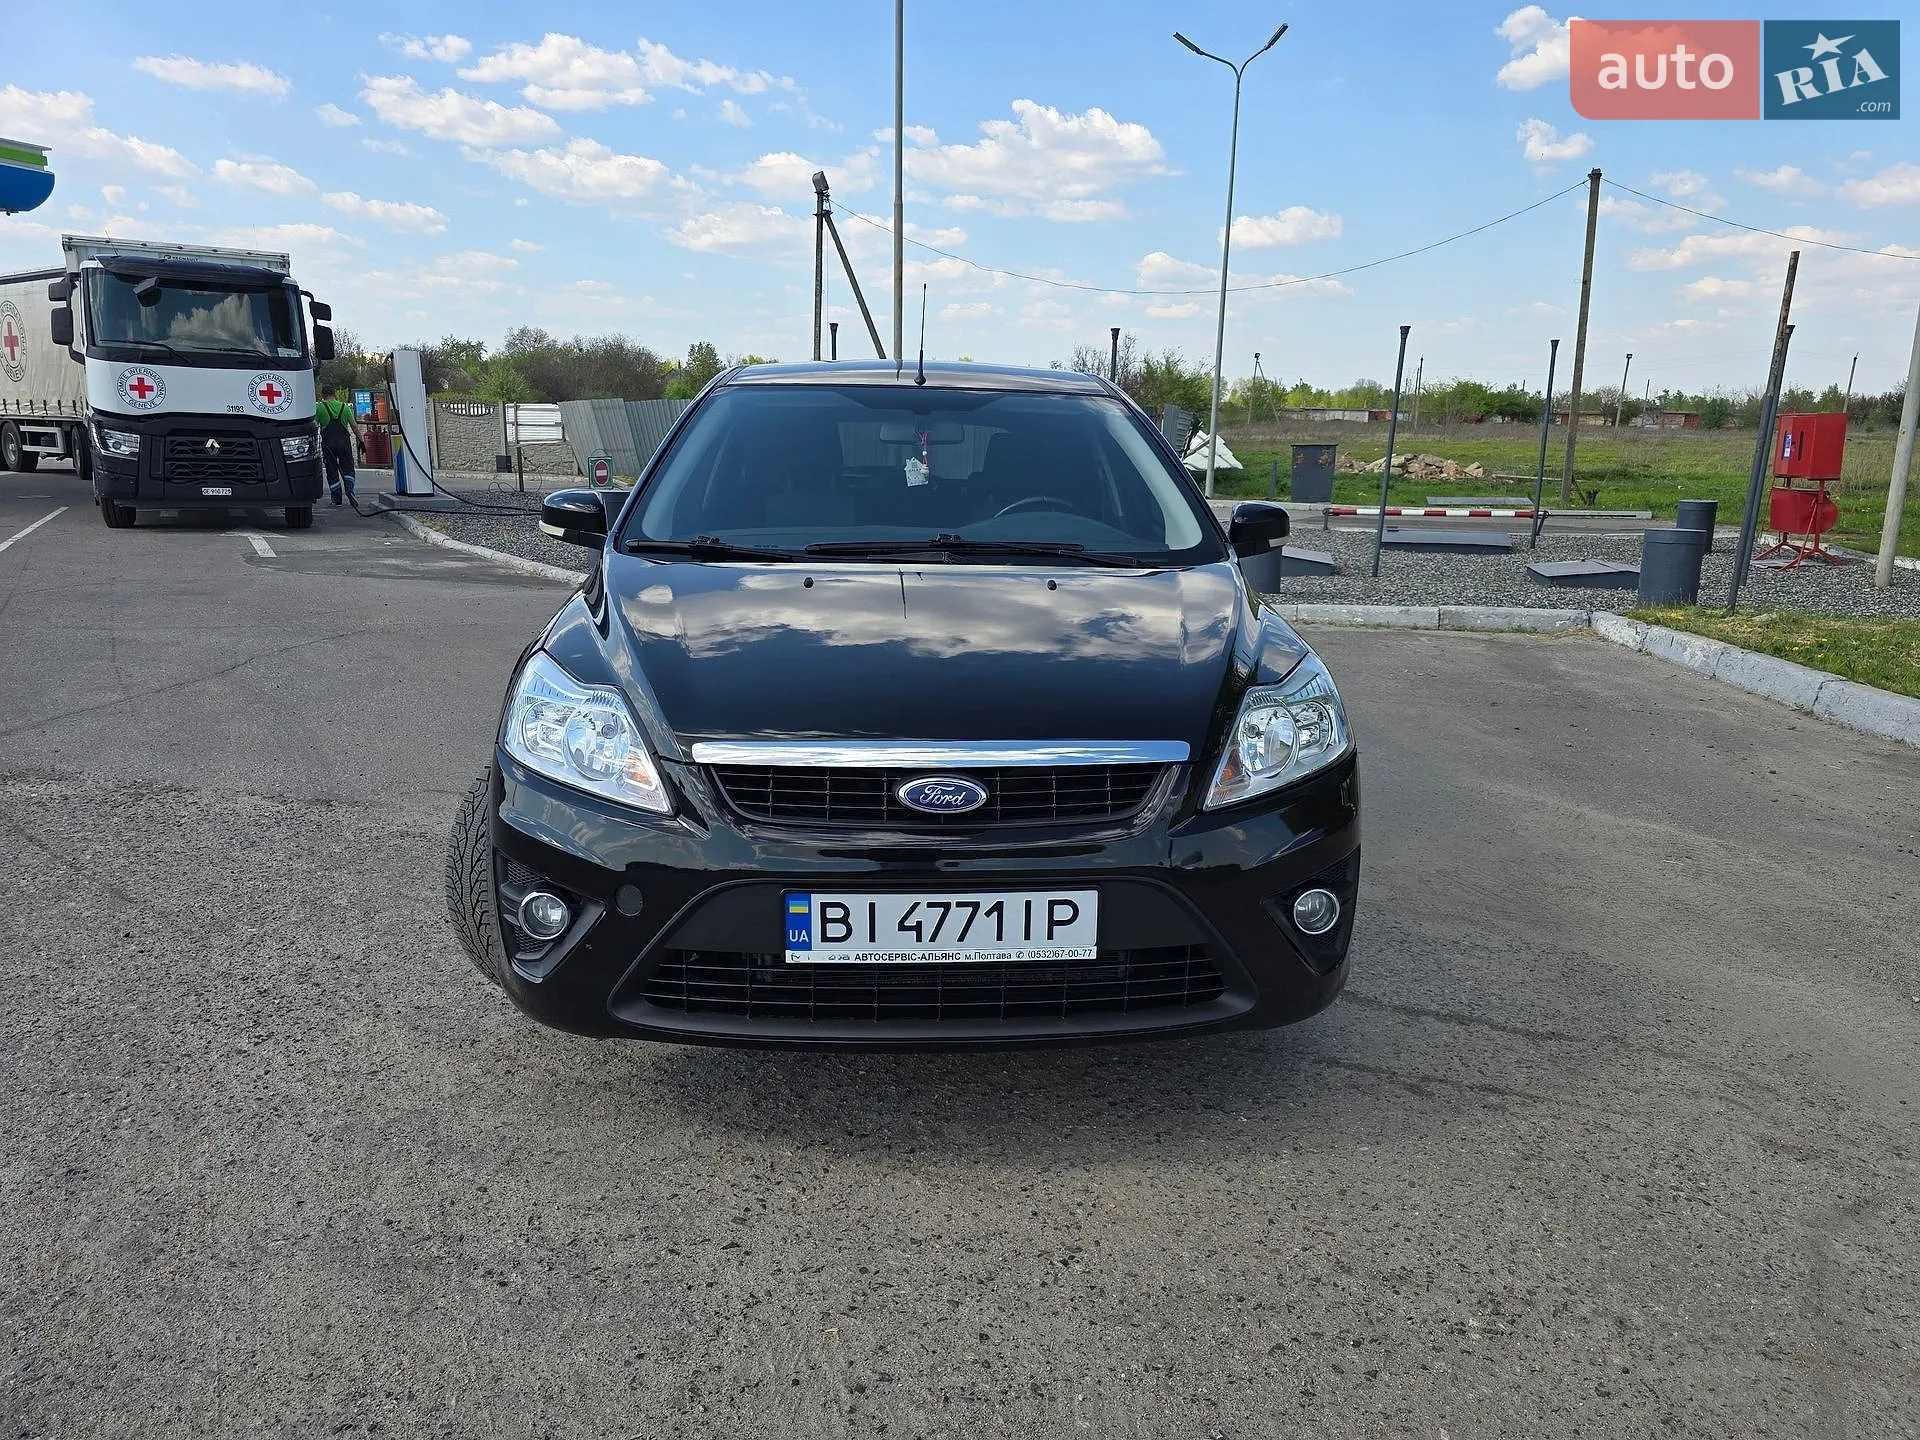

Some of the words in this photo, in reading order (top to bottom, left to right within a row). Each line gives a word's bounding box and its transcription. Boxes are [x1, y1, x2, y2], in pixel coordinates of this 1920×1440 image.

[226, 405, 245, 413] 31193
[920, 784, 966, 805] Ford
[819, 901, 876, 943] BI
[897, 900, 1004, 943] 4771
[1023, 899, 1080, 941] IP
[789, 930, 809, 942] UA
[854, 952, 961, 962] АВТОСЕРВІС-АЛЬЯНС
[964, 951, 1012, 961] м.Полтава
[1027, 949, 1093, 959] (0532)67-00-77
